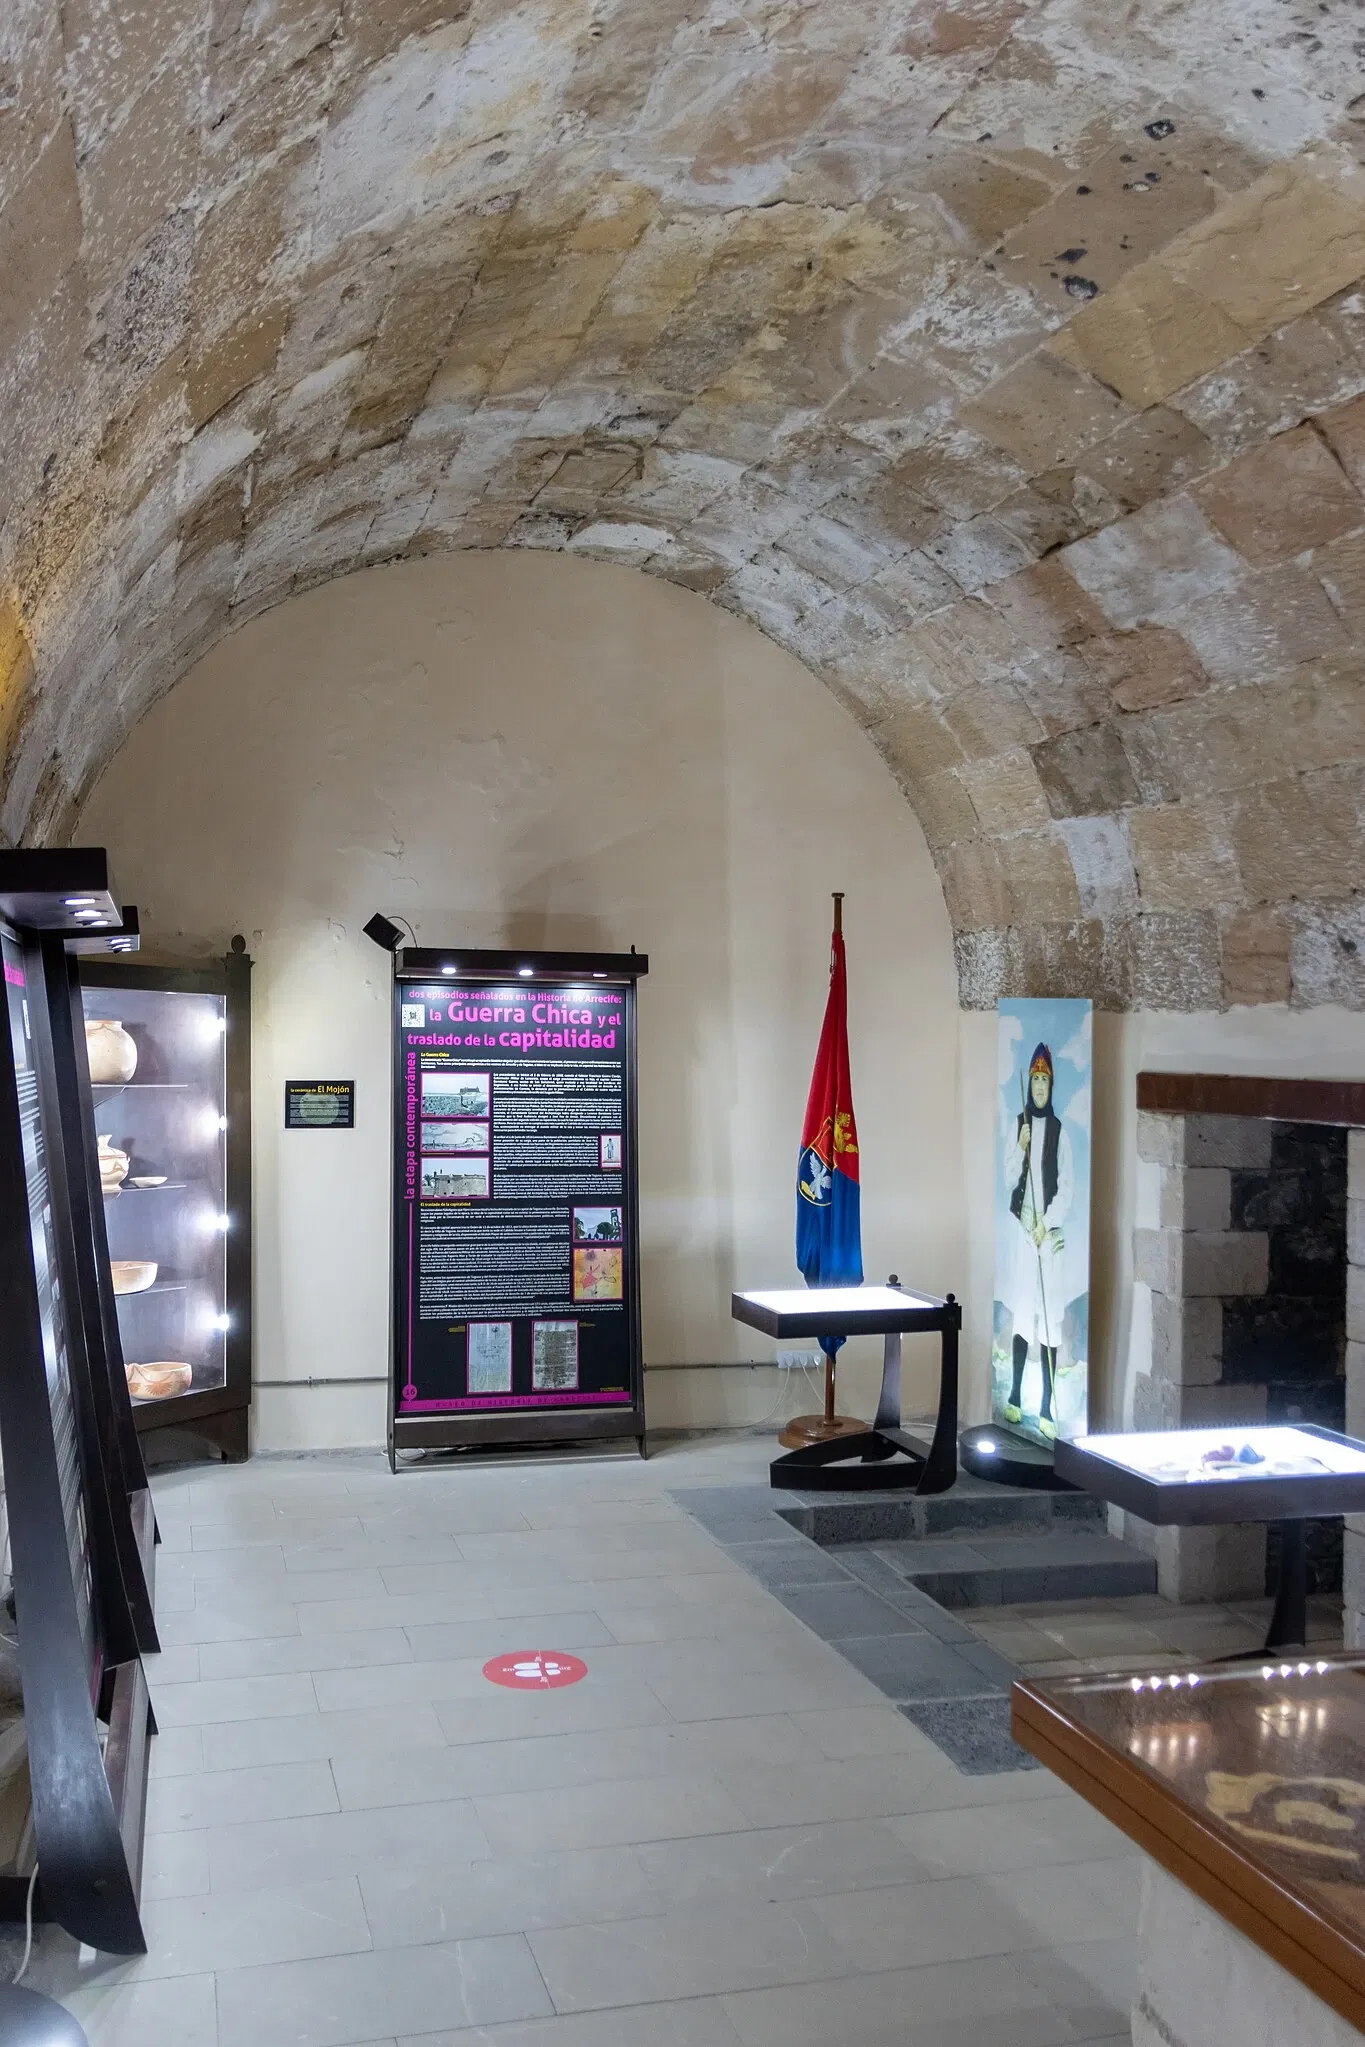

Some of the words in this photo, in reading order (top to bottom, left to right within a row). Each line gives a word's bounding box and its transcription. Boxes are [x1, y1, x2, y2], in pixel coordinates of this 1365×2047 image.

[409, 989, 424, 998] dos
[427, 990, 468, 1000] episodios
[471, 991, 513, 1001] señalados
[528, 993, 536, 1001] la
[538, 992, 571, 1002] Historia
[429, 1008, 442, 1021] la
[448, 1001, 526, 1023] Guerra
[532, 1003, 592, 1024] Chica
[597, 1014, 606, 1028] y
[608, 1012, 621, 1025] el
[407, 1033, 461, 1046] traslado
[464, 1033, 480, 1046] de
[484, 1033, 496, 1046] la
[499, 1027, 615, 1052] capitalidad
[326, 1085, 350, 1094] Mojón
[404, 1052, 418, 1148] contemporánea
[405, 1151, 418, 1186] etapa
[404, 1188, 415, 1200] la
[405, 1387, 416, 1396] 16
